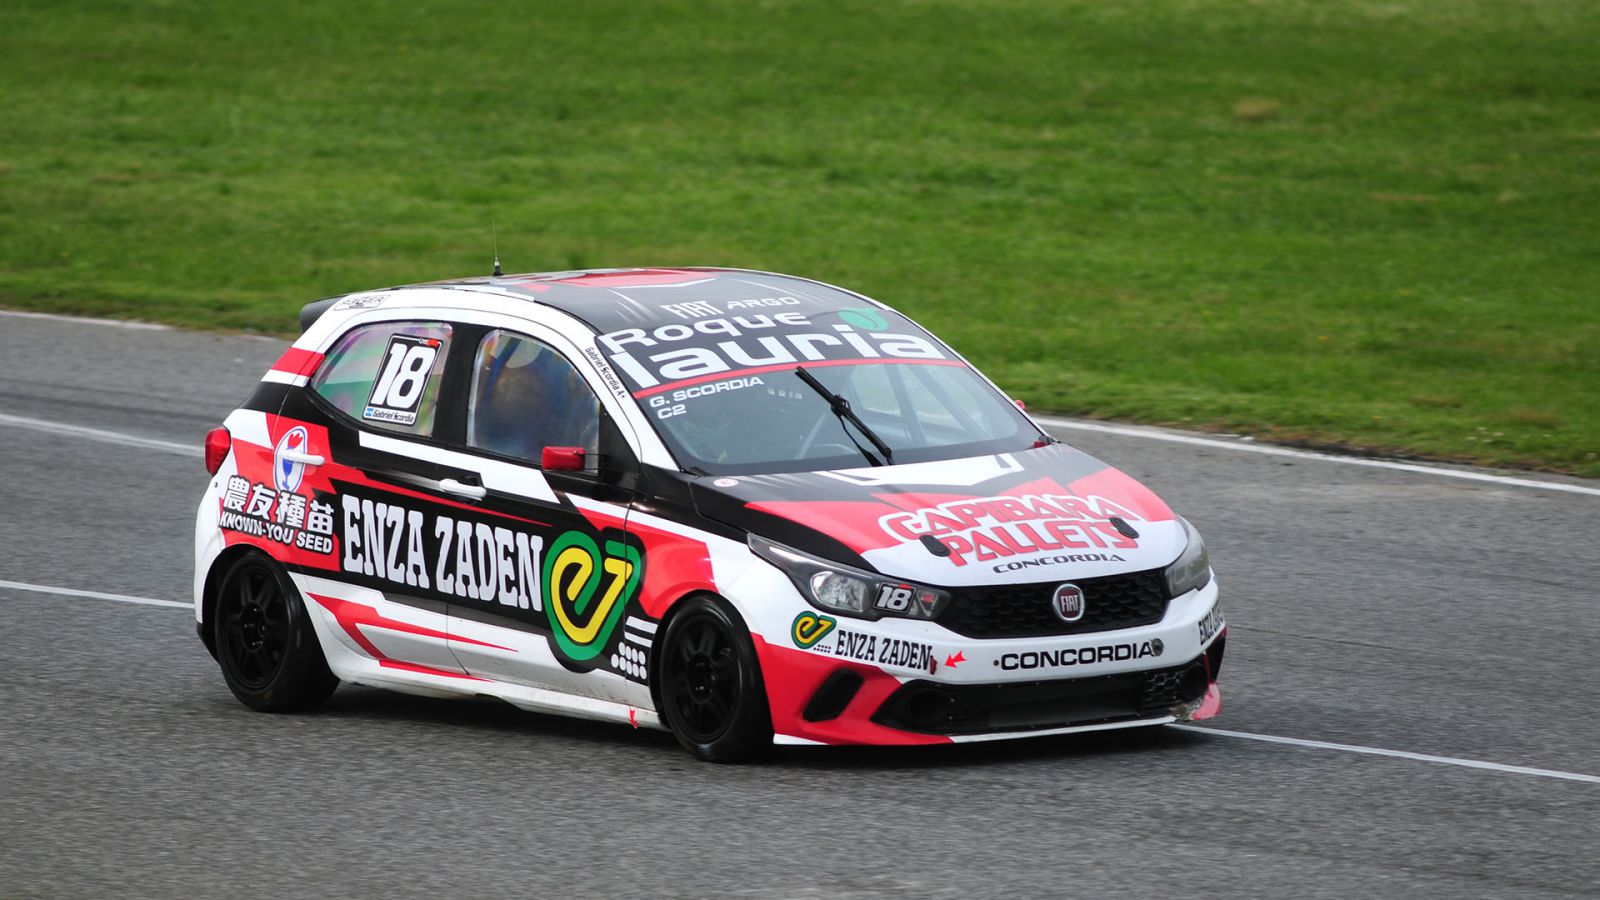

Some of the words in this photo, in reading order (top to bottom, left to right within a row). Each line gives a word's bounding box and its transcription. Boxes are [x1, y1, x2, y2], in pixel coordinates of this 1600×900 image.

[660, 300, 725, 319] FIAT
[727, 297, 800, 310] ARGO
[597, 312, 812, 354] Roque
[370, 342, 437, 409] 18
[585, 347, 606, 368] Gabriel
[600, 366, 620, 391] Scordia
[610, 324, 946, 389] lauria
[650, 395, 671, 409] G.
[674, 376, 765, 401] SCORDIA
[657, 404, 687, 420] C2
[373, 410, 394, 420] Gabriel
[394, 412, 415, 422] Scordia
[222, 477, 335, 536] 農友種苗
[886, 497, 1140, 540] CAPIBARA
[219, 511, 294, 543] KNOWN-YOU
[296, 532, 333, 554] SEED
[342, 494, 430, 589] ENZA
[435, 516, 543, 612] ZADEN
[937, 519, 1139, 567] PALLETS
[993, 552, 1127, 574] CONCORDIA
[876, 586, 911, 611] 18
[1060, 594, 1079, 612] FIAT
[835, 629, 876, 661] ENZA
[878, 638, 933, 671] ZADEN
[1001, 641, 1155, 671] CONCORDIA
